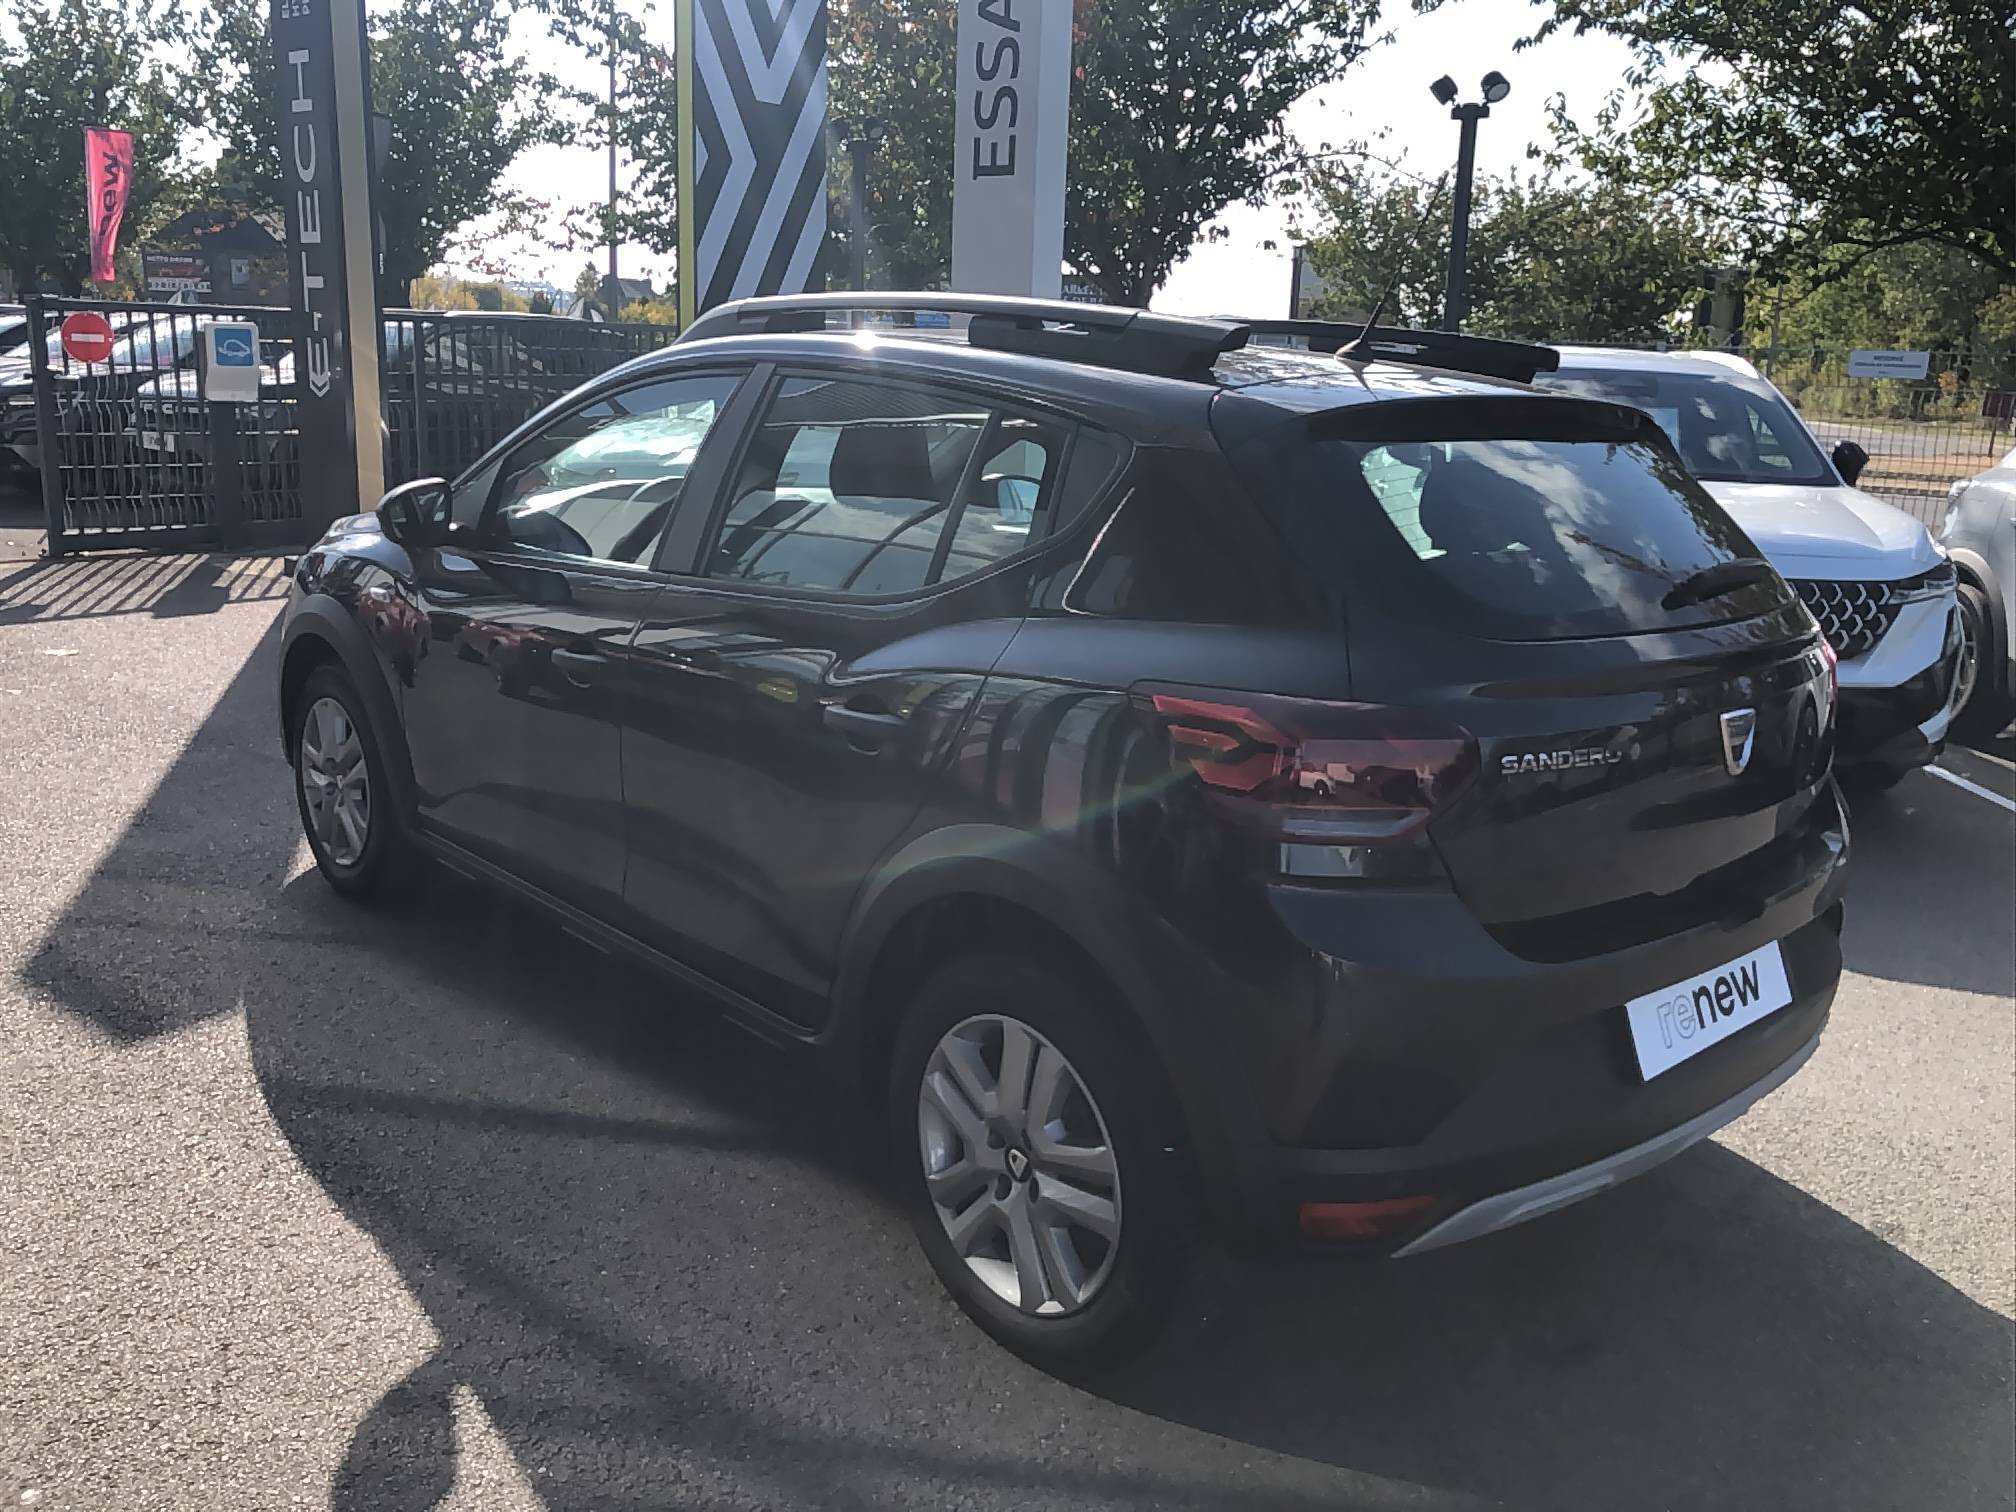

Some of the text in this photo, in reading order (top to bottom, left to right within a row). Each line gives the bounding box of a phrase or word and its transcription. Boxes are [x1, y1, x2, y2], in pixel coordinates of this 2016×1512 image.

[972, 0, 1021, 180] ESSA
[288, 49, 330, 398] E-TECH
[1656, 959, 1760, 1049] renew
